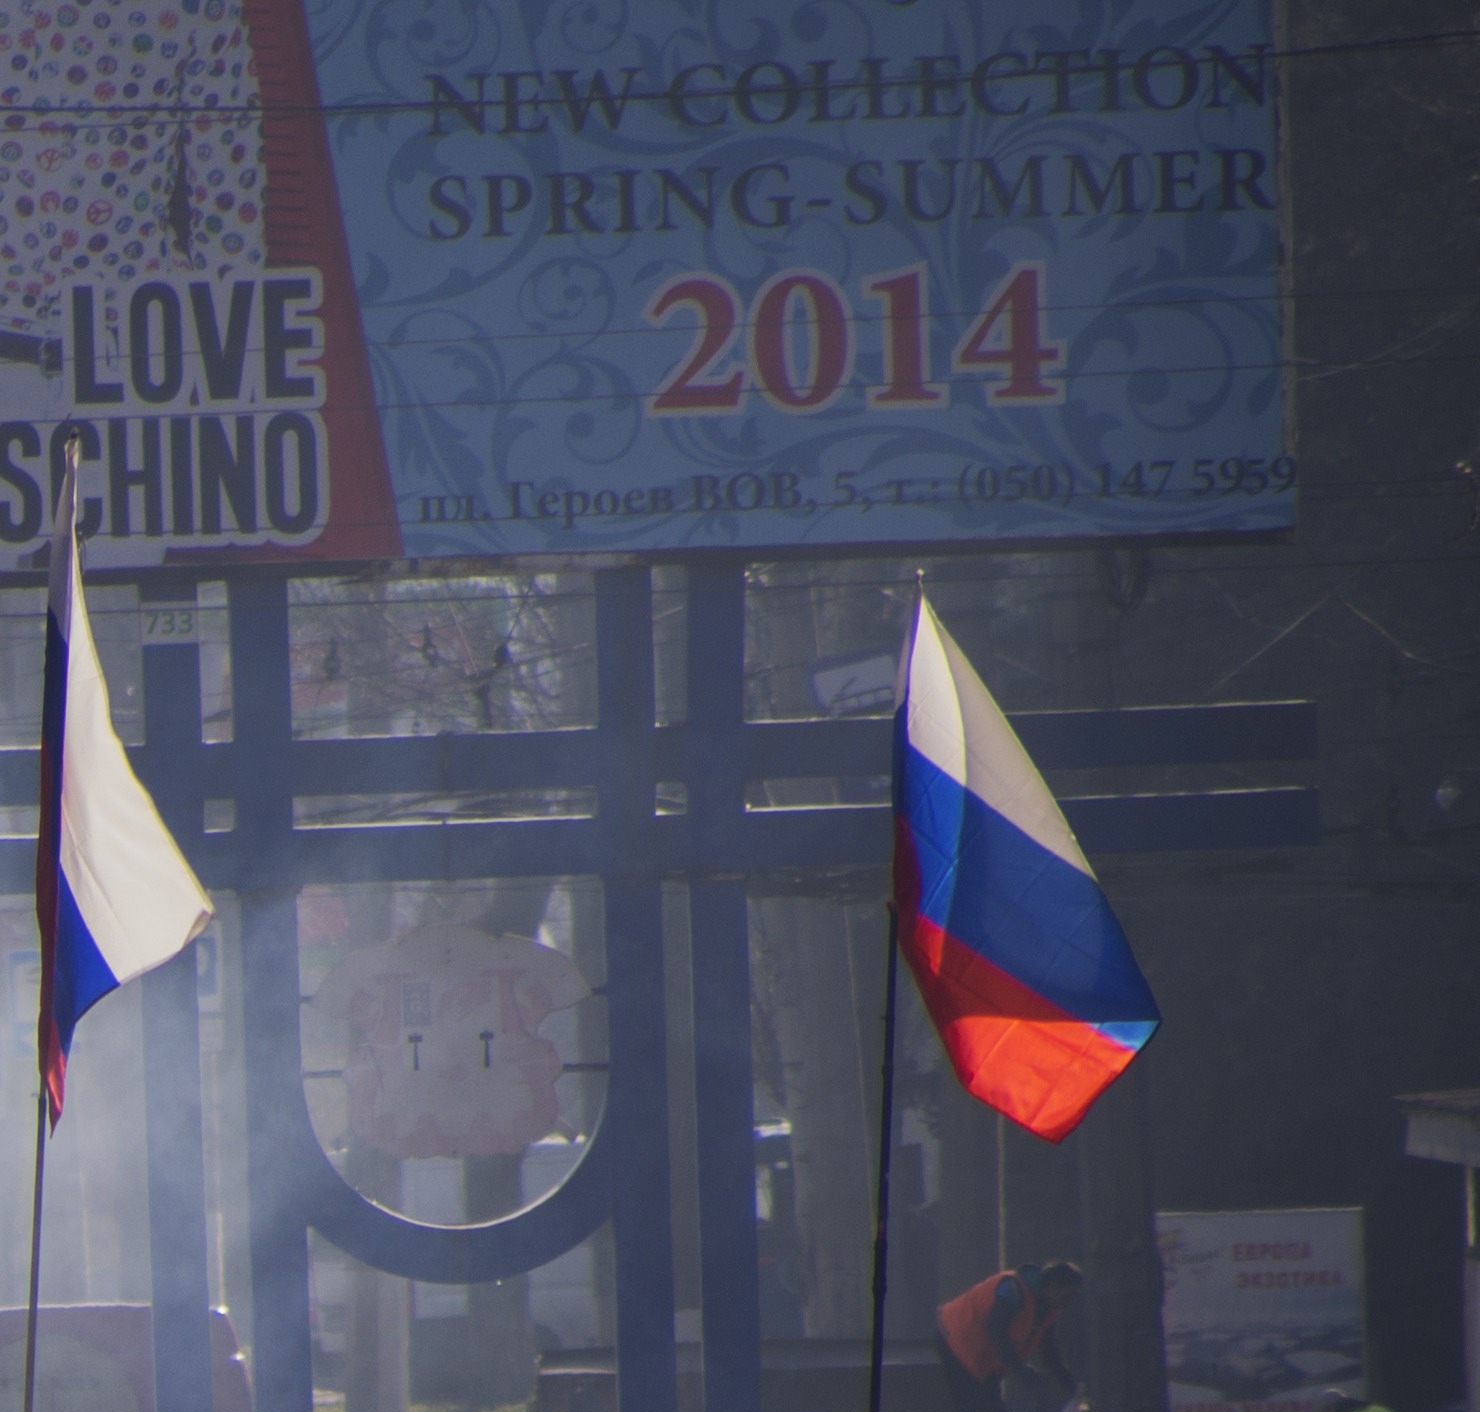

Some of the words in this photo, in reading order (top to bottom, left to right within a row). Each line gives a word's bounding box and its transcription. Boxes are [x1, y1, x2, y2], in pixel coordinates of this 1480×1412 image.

[423, 66, 642, 137] NEW
[668, 41, 1270, 129] COLLECTION
[427, 147, 1276, 242] SPRING-SUMMER
[72, 278, 317, 405] LOVE
[646, 262, 1064, 414] 2014
[419, 496, 490, 524] пл.
[509, 481, 673, 530] Героев
[690, 471, 817, 514] ВОВ,
[832, 471, 873, 513] 5,
[958, 463, 1075, 508] (050)
[1093, 459, 1176, 498] 147
[1192, 456, 1298, 496] 5959
[145, 611, 194, 636] 733
